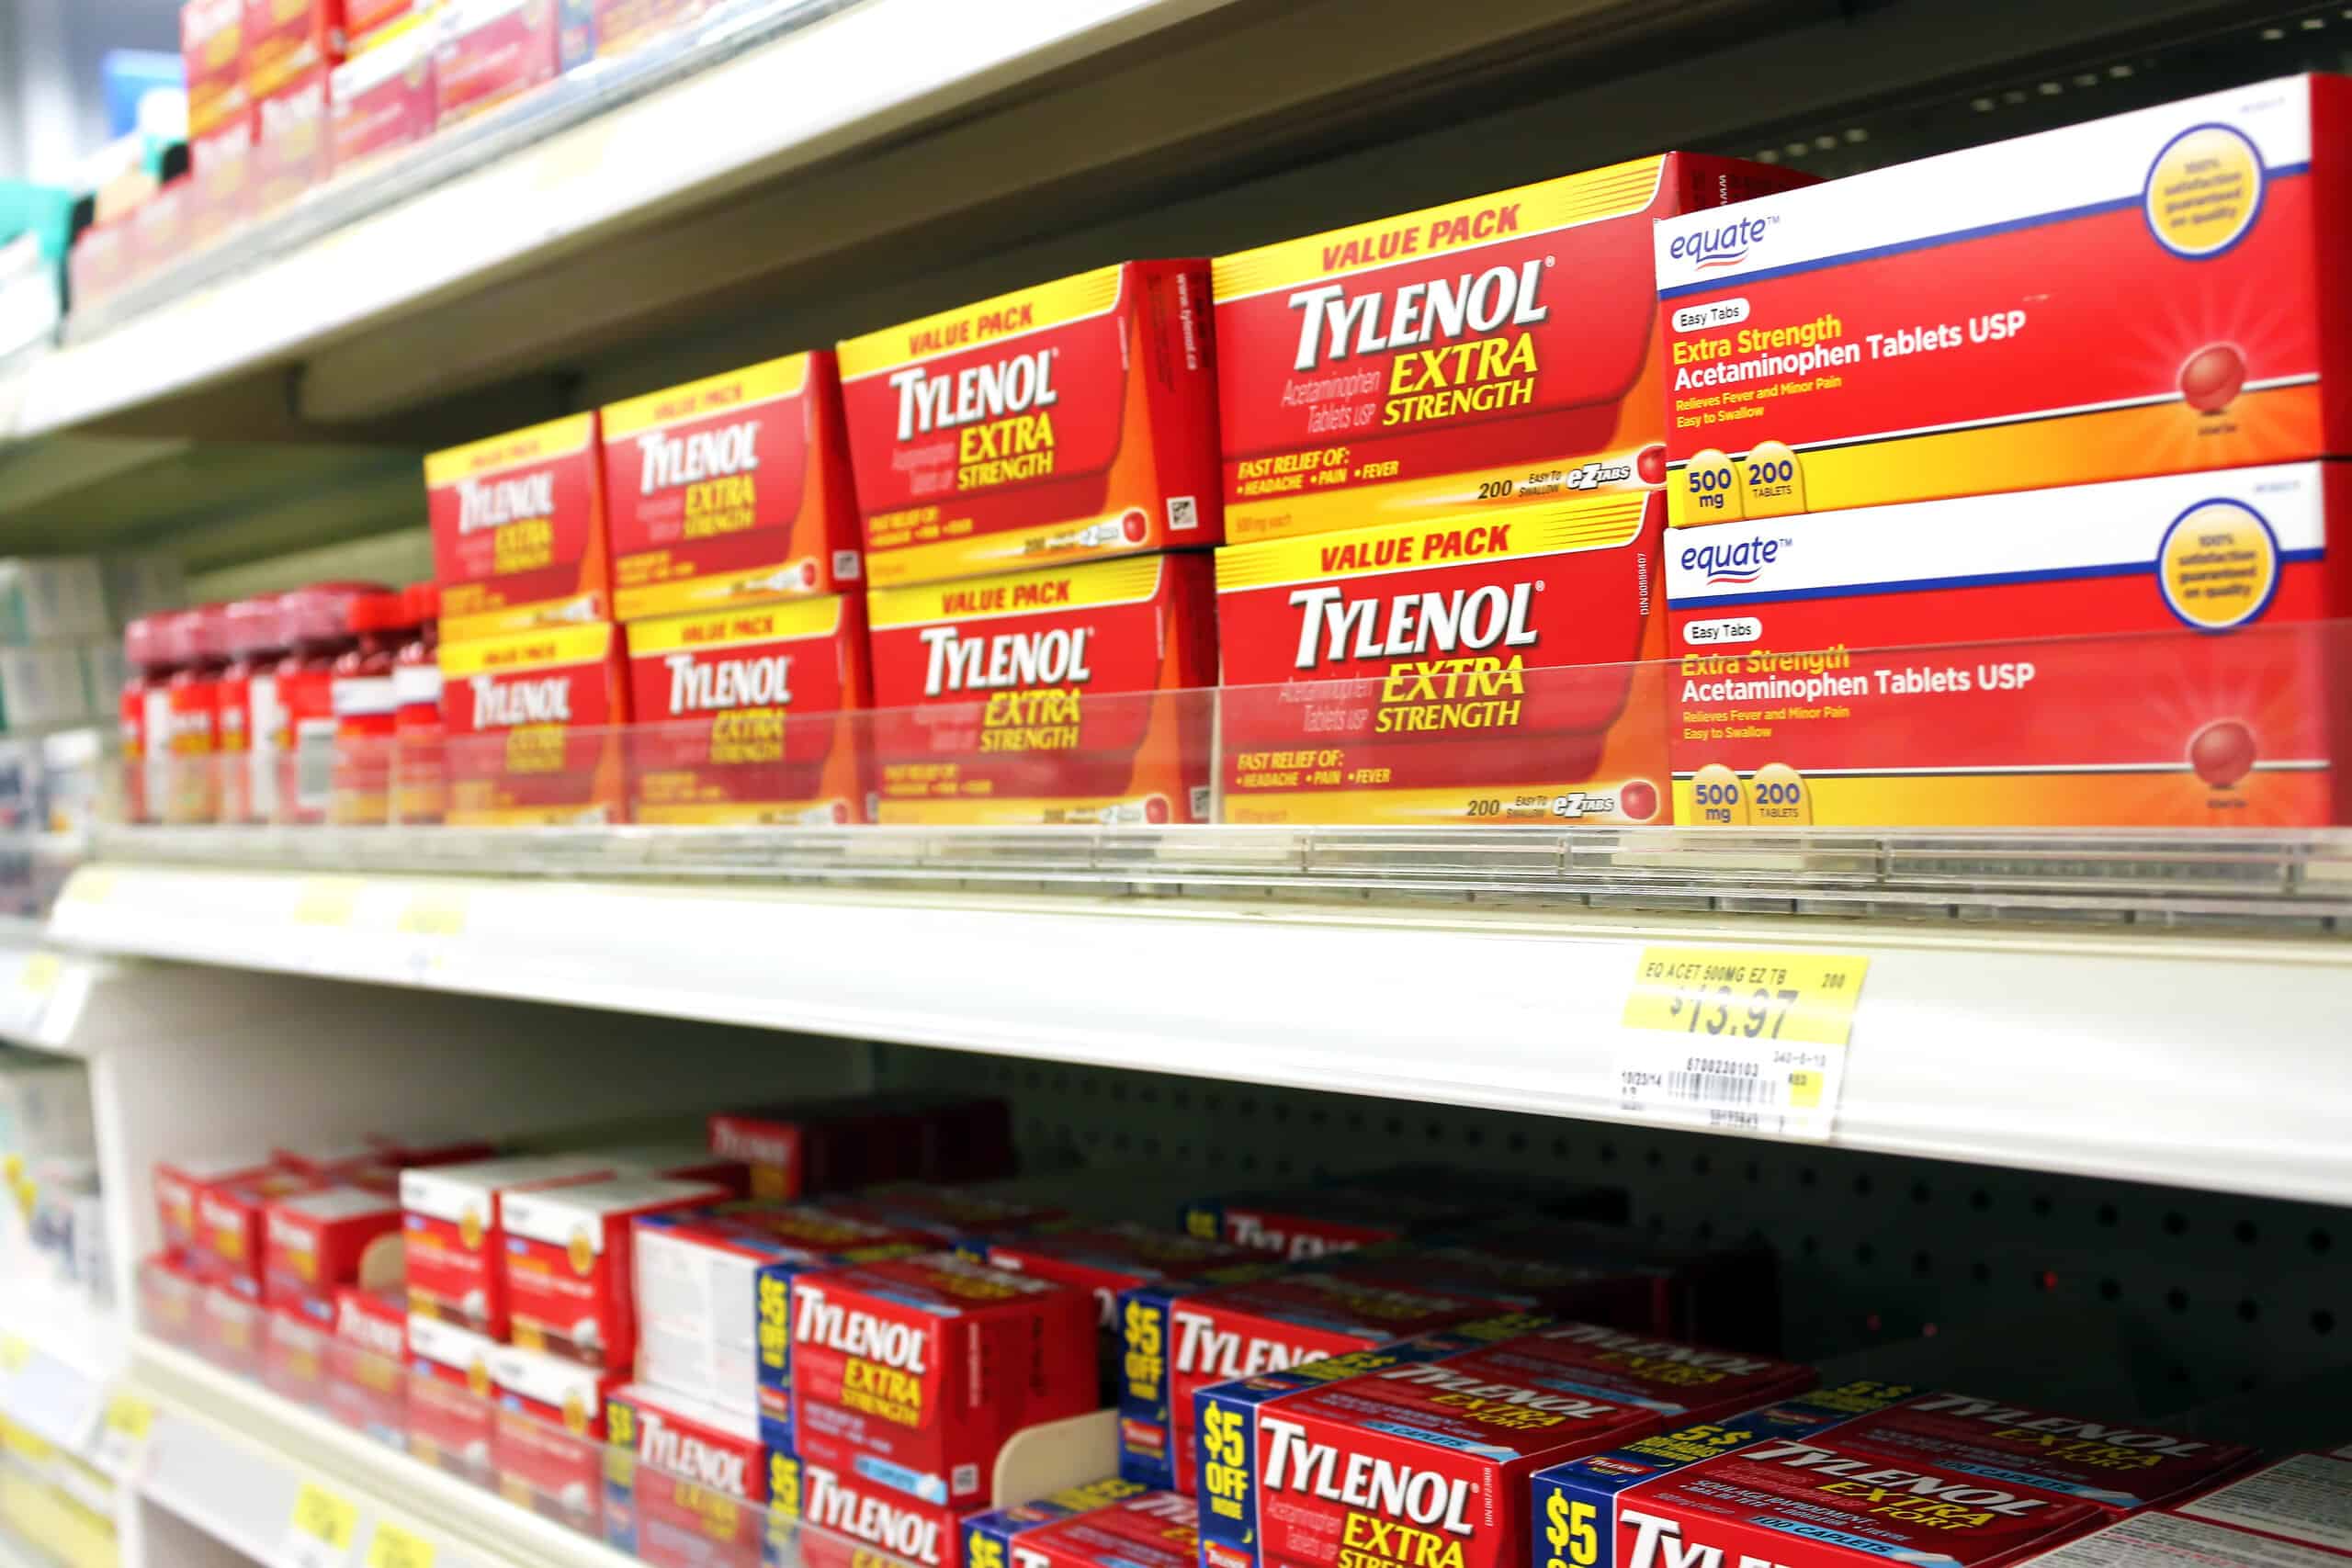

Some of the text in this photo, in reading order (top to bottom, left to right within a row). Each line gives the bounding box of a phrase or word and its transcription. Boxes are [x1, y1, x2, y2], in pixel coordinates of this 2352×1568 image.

[1321, 203, 1521, 272] VALUE PACK
[1669, 216, 1766, 262] equate
[908, 303, 1035, 356] VALUE PACK
[1287, 258, 1548, 371] TYLENOL
[1679, 304, 1739, 327] Easy Tabs
[1672, 313, 1842, 366] Extra Strength
[1674, 310, 2028, 391] Acetaminophen Tablets USP
[1388, 332, 1537, 396] EXTRA
[889, 349, 1057, 441] TYLENOL
[1382, 378, 1535, 427] STRENGTH
[1676, 374, 1843, 412] Relieves Fever and Minor Pain
[1676, 403, 1764, 428] Easy to Swallow
[637, 421, 760, 495] TYLENOL
[958, 412, 1055, 463] EXTRA
[957, 452, 1054, 491] STRENGTH
[1238, 458, 1273, 480] FAST
[1273, 451, 1323, 474] RELIEF
[1363, 461, 1399, 479] FEVER
[1689, 459, 1793, 493] 500 200
[456, 472, 553, 535] TYLENOL
[684, 477, 755, 515] EXTRA
[1477, 479, 1513, 499] 200
[1699, 485, 1792, 509] mg TABLETS
[1320, 524, 1511, 573] VALUE PACK
[1680, 536, 1779, 576] equate
[941, 580, 1071, 615] VALUE PACK
[1288, 581, 1538, 671] TYLENOL
[1691, 623, 1751, 640] Easy Tabs
[920, 626, 1091, 696] TYLENOL
[1380, 654, 1525, 704] EXTRA
[1681, 644, 1850, 677] Extra Strength
[1681, 662, 2036, 703] Acetaminophen Tablets USP
[469, 673, 571, 729] TYLENOL
[664, 653, 793, 716] TYLENOL
[982, 687, 1081, 728] EXTRA
[1374, 699, 1521, 734] STRENGTH
[1683, 705, 1850, 724] Relieves Fever and Minor Pain
[1683, 726, 1772, 741] Easy to Swallow
[978, 725, 1079, 752] STRENGTH
[1238, 752, 1269, 771] FAST
[1271, 750, 1317, 769] RELIEF
[1467, 799, 1500, 817] 200
[1696, 784, 1801, 805] 500 200
[1705, 807, 1799, 823] mg TABLETS
[1645, 963, 1661, 977] EQ
[1667, 964, 1702, 979] ACET
[1748, 967, 1767, 984] EZ
[1770, 968, 1787, 985] TB
[795, 1283, 927, 1372] TYLENOL
[1124, 1296, 1161, 1356] $5
[842, 1358, 922, 1408] EXTRA
[1383, 1361, 1619, 1421] TYLENOL
[1204, 1399, 1246, 1469] $5
[1909, 1393, 2210, 1458] TYLENOL
[1990, 1427, 2164, 1467] EXTRA
[1204, 1461, 1249, 1502] OFF
[1260, 1416, 1475, 1538] TYLENOL
[1740, 1438, 2050, 1517] TYLENOL
[805, 1464, 942, 1567] TYLENOL
[1545, 1487, 1597, 1566] $5
[1816, 1480, 1996, 1528] EXTRA
[1868, 1506, 1975, 1529] FORT
[1342, 1512, 1465, 1568] EXTRA
[1794, 1526, 1894, 1554] CAPLETS
